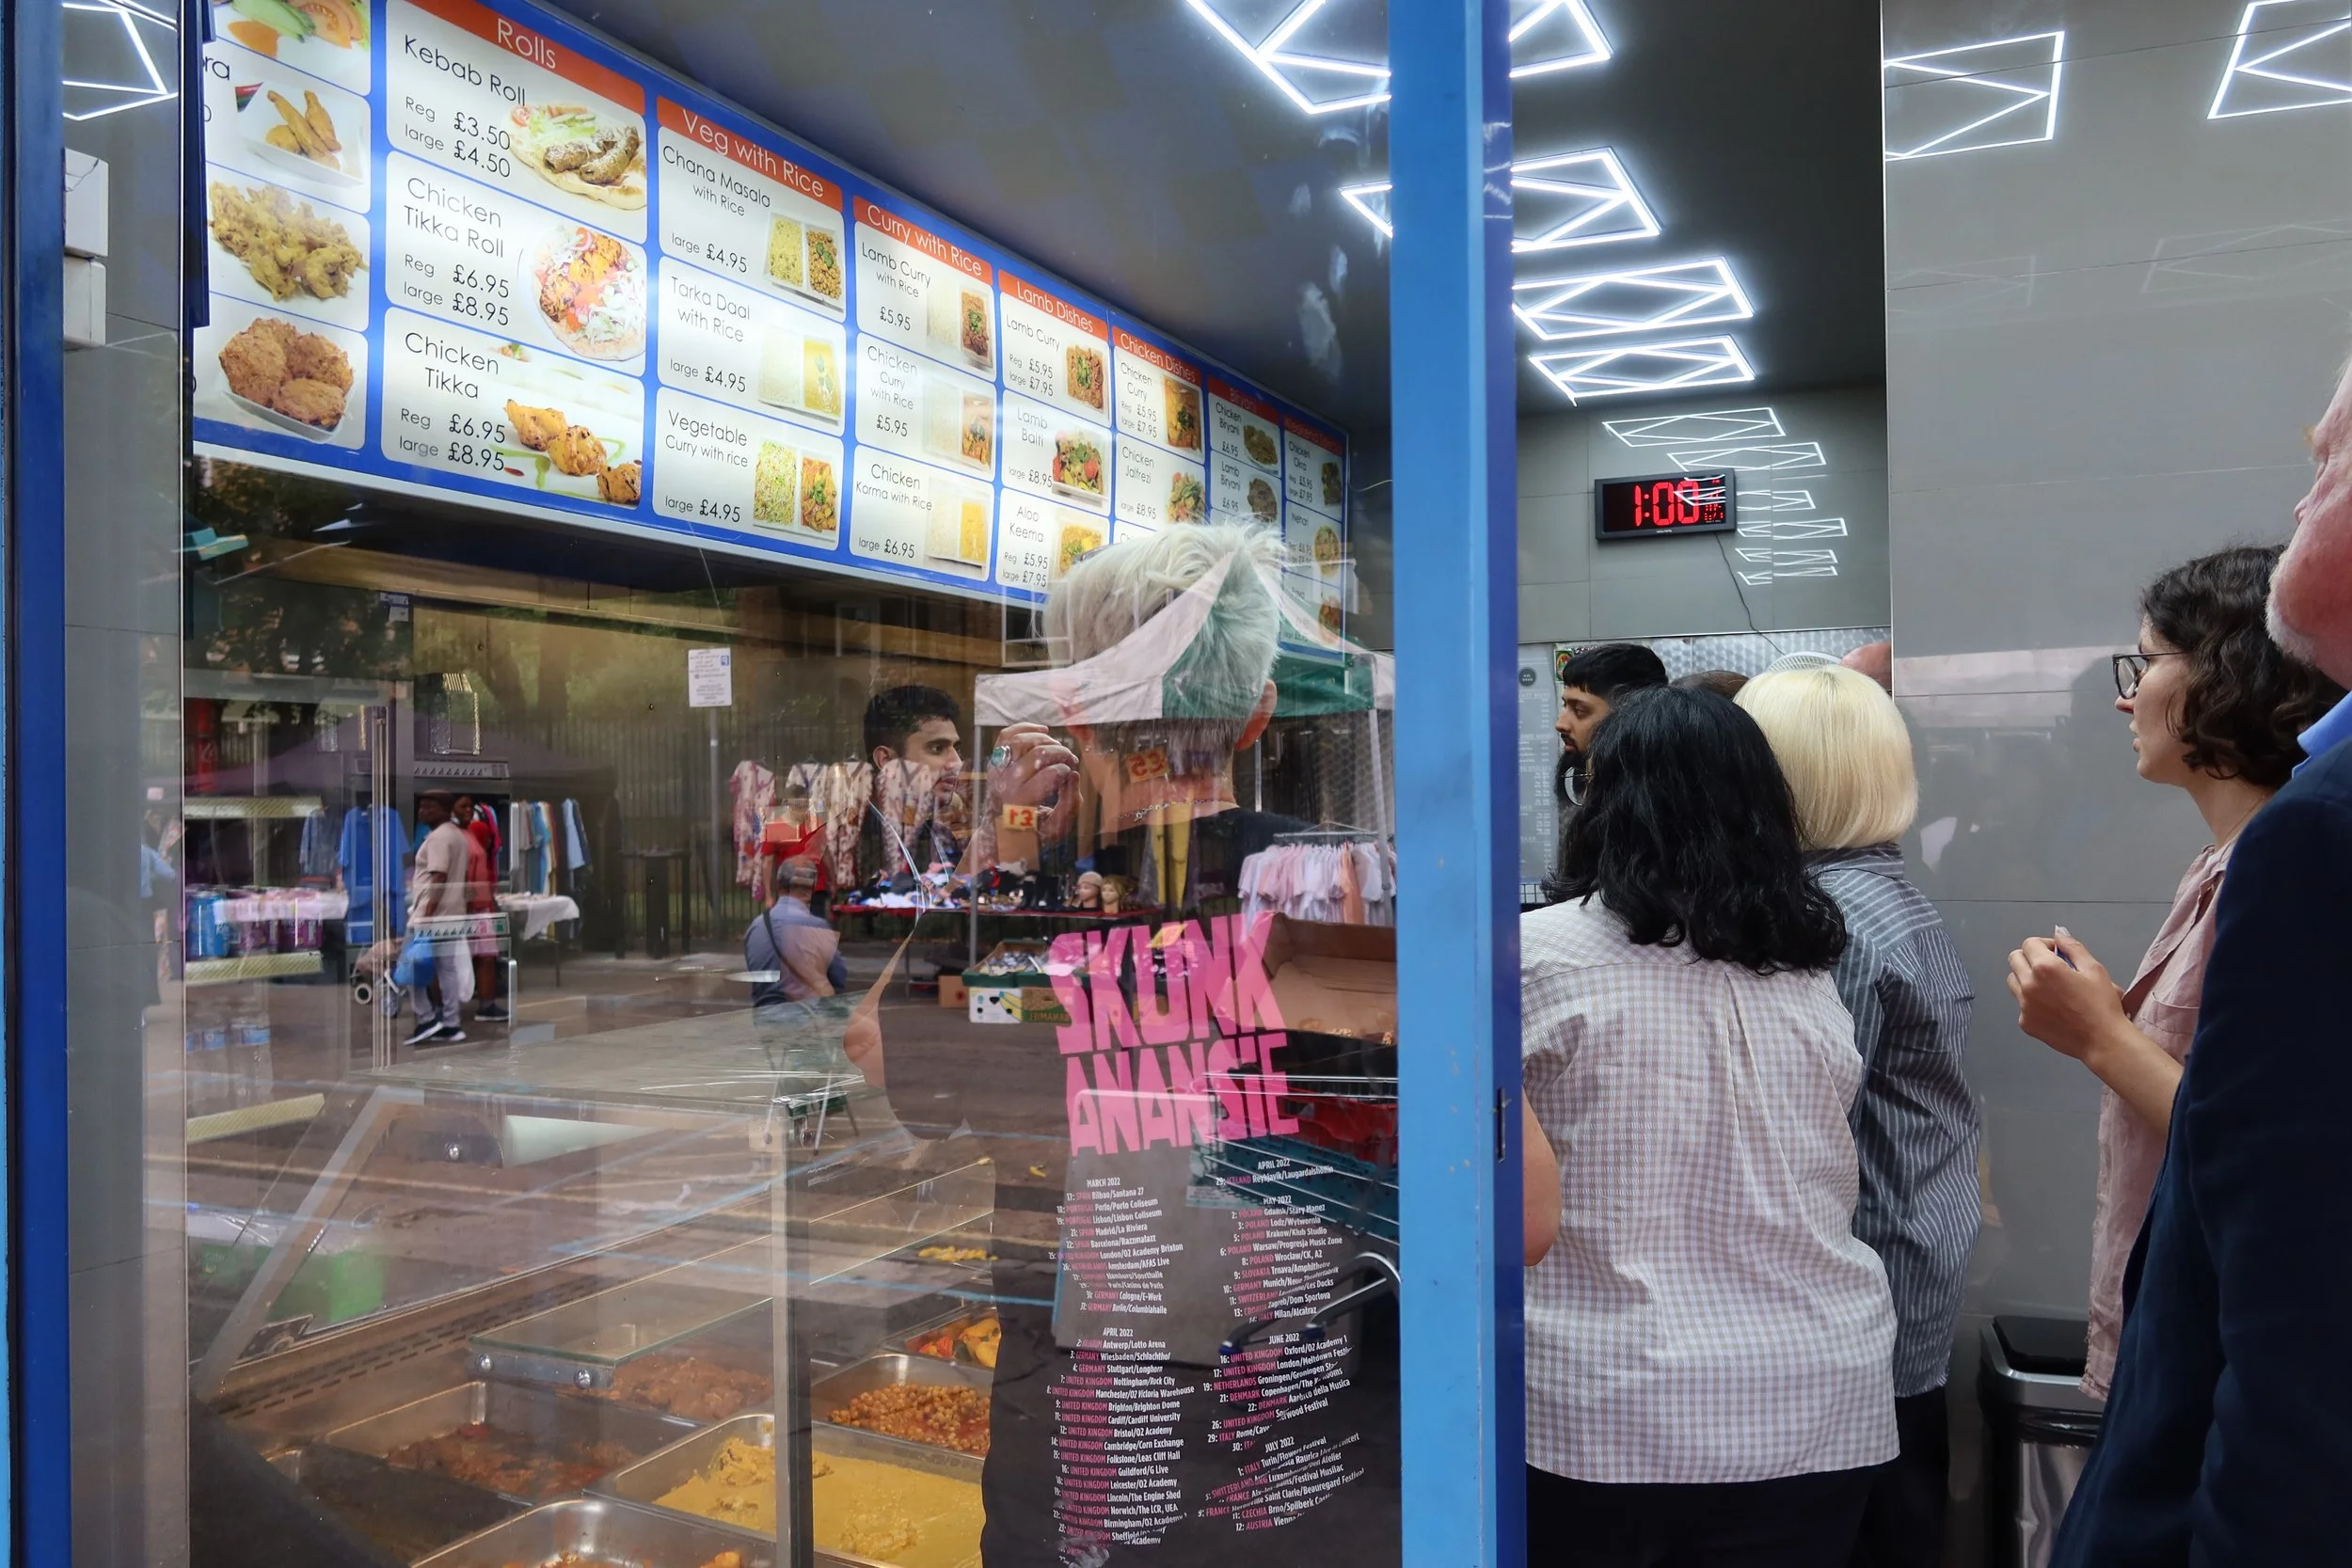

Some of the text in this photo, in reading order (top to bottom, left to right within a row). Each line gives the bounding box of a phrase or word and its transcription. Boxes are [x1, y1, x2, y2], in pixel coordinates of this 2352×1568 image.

[498, 18, 556, 69] Rolls
[202, 56, 230, 80] ra
[405, 35, 526, 107] Kebab Roll
[405, 96, 511, 150] Reg £3.50
[405, 124, 511, 178] large £4.50
[683, 109, 823, 198] Veg with Rice
[663, 146, 771, 207] Chana Masala
[407, 178, 501, 228] Chicken
[693, 184, 744, 216] with Rice
[405, 206, 502, 258] Tikka Roll
[868, 205, 981, 277] Curry with Rice
[673, 233, 747, 273] large £4.95
[405, 254, 509, 299] Reg £6.95
[862, 243, 930, 288] Lamb Curry
[877, 271, 918, 298] with Rice
[405, 281, 509, 325] large £8.95
[671, 277, 750, 319] Tarka Daal
[1017, 281, 1092, 333] Lamb Dishes
[678, 308, 743, 342] with Rice
[880, 307, 911, 331] £5.95
[1007, 314, 1059, 352] Lamb Curry
[405, 333, 499, 374] Chicken
[867, 346, 917, 375] Chicken
[1120, 334, 1195, 382] Chicken Dishes
[671, 358, 745, 393] large £4.95
[1009, 354, 1053, 379] Reg £5.95
[1121, 362, 1152, 386] Chicken
[425, 367, 478, 399] Tikka
[881, 372, 905, 390] Curry
[1009, 371, 1053, 396] large £7.95
[1127, 383, 1147, 402] Curry
[871, 387, 914, 410] with Rice
[1017, 406, 1047, 429] Lamb
[1216, 403, 1242, 422] Chicken
[401, 408, 505, 443] Reg £6.95
[669, 410, 747, 446] Vegetable
[877, 415, 907, 436] £5.95
[1022, 428, 1043, 447] Balti
[1137, 420, 1156, 437] £7.95
[400, 436, 504, 470] large £8.95
[665, 436, 748, 467] Curry with rice
[1122, 447, 1154, 467] Chicken
[871, 464, 920, 489] Chicken
[1009, 466, 1052, 487] large £8.95
[1126, 466, 1151, 483] Jalfrezi
[1222, 461, 1239, 477] Lamb
[856, 482, 931, 511] Korma with Rice
[1635, 481, 1699, 527] 1:00
[666, 496, 739, 523] large £4.95
[1017, 506, 1039, 522] Aloo
[1137, 503, 1156, 519] £8.95
[1009, 523, 1043, 543] Keema
[859, 537, 914, 558] large £6.95
[1005, 552, 1048, 570] Reg £5.95
[1003, 569, 1046, 587] large £7.95
[1049, 911, 1286, 1054] SKUNK
[1066, 1033, 1299, 1156] ANANSIE
[1087, 1179, 1106, 1187] MARCH
[1131, 1198, 1158, 1208] Coliseum
[1135, 1210, 1162, 1219] Coliseum
[1133, 1243, 1183, 1257] Academy Brixton
[1228, 1244, 1251, 1254] POLAND
[1310, 1238, 1326, 1246] Music
[1103, 1327, 1133, 1337] APRIL 2022
[1269, 1333, 1299, 1344] JUNE 2022
[1231, 1347, 1283, 1363] UNITED KINGDOM
[1066, 1376, 1175, 1386] UNITED KINGDOM City
[1079, 1365, 1105, 1373] GERMANY
[1160, 1386, 1194, 1397] Warehouse
[1214, 1377, 1256, 1389] NETHERLANDS
[1162, 1401, 1180, 1409] Dome
[1230, 1390, 1259, 1401] DENMARK
[1150, 1413, 1181, 1422] University
[1154, 1438, 1184, 1449] Exchange
[1168, 1451, 1180, 1460] Hall
[1265, 1436, 1295, 1452] JULY 2022
[1242, 1507, 1267, 1518] CZECHIA
[1246, 1519, 1272, 1529] AUSTRIA
